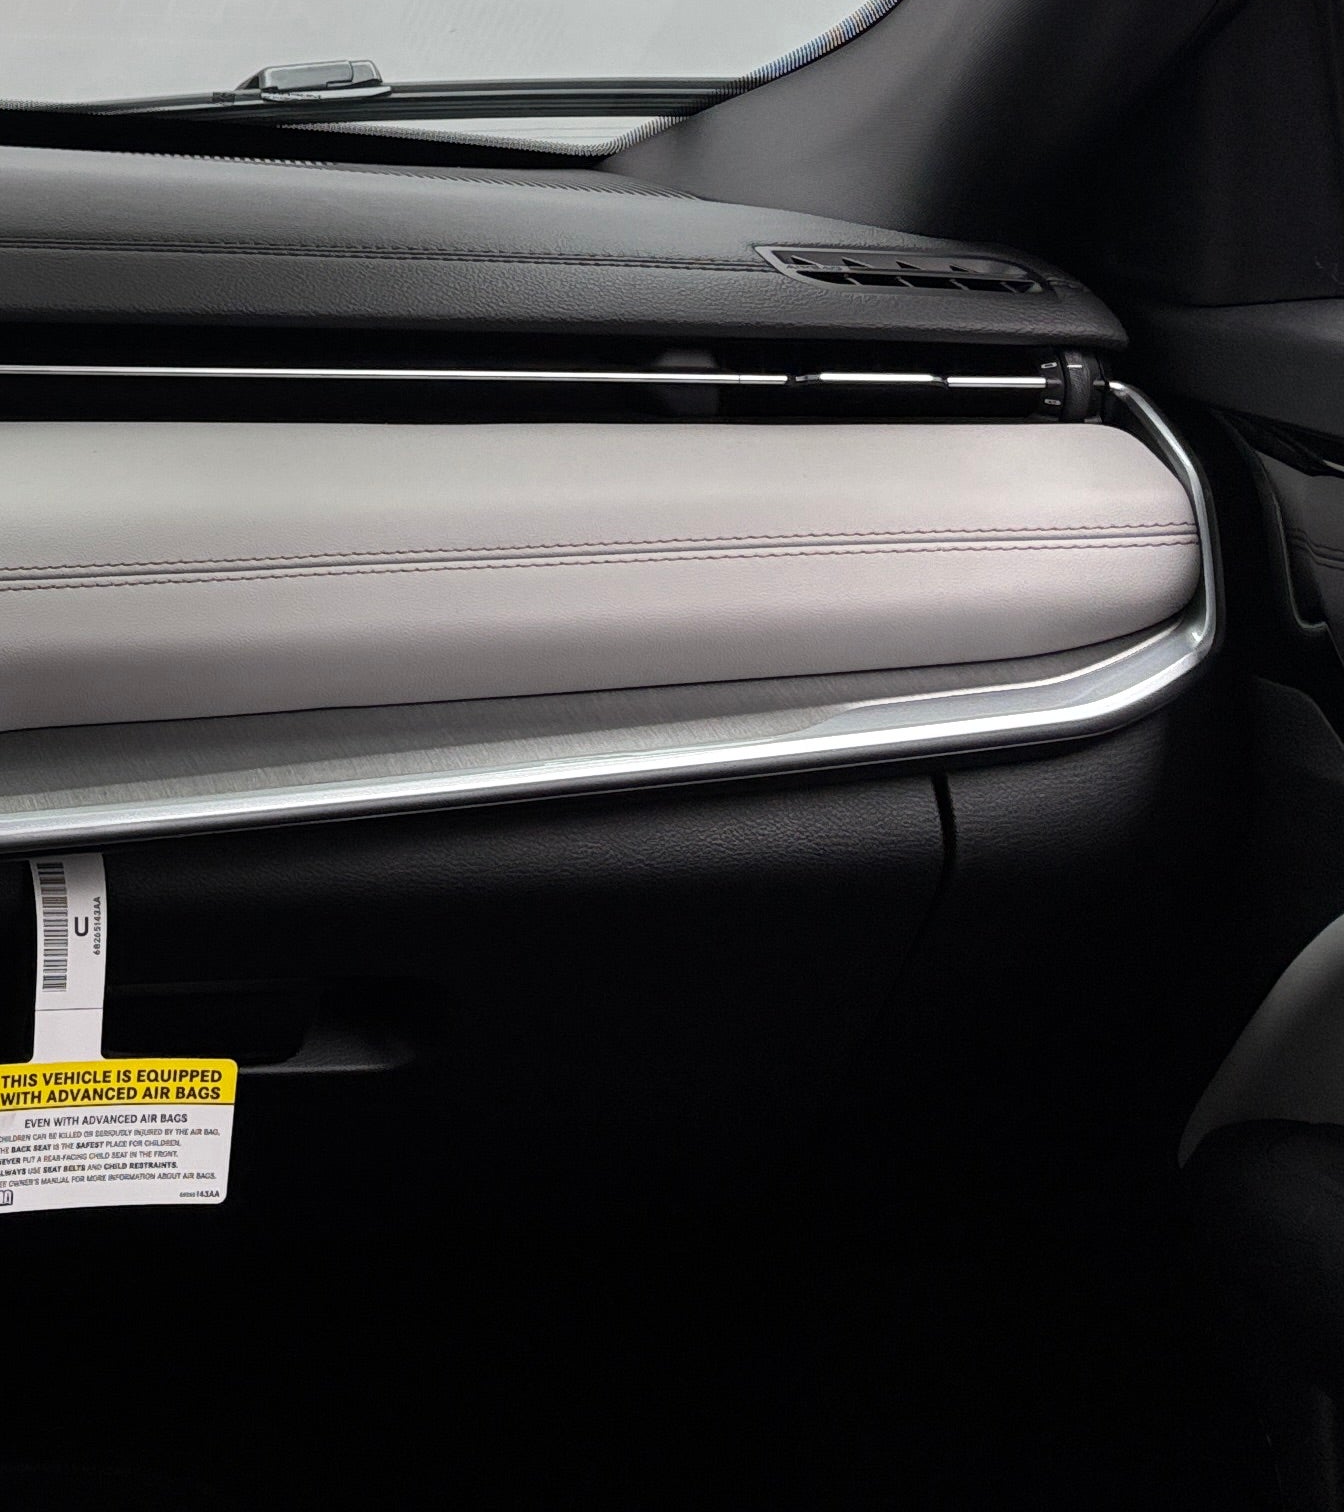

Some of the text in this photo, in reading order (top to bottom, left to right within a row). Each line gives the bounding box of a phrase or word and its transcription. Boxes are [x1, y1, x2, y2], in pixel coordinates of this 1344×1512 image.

[74, 916, 89, 937] U
[1, 1070, 222, 1088] THIS VEHICLE IS EQUIPPED
[1, 1087, 220, 1106] WITH ADVANCED AIR BAGS
[25, 1113, 188, 1128] EVEN WITH ADVANCED AIR BAGS
[76, 1141, 104, 1149] SAFEST
